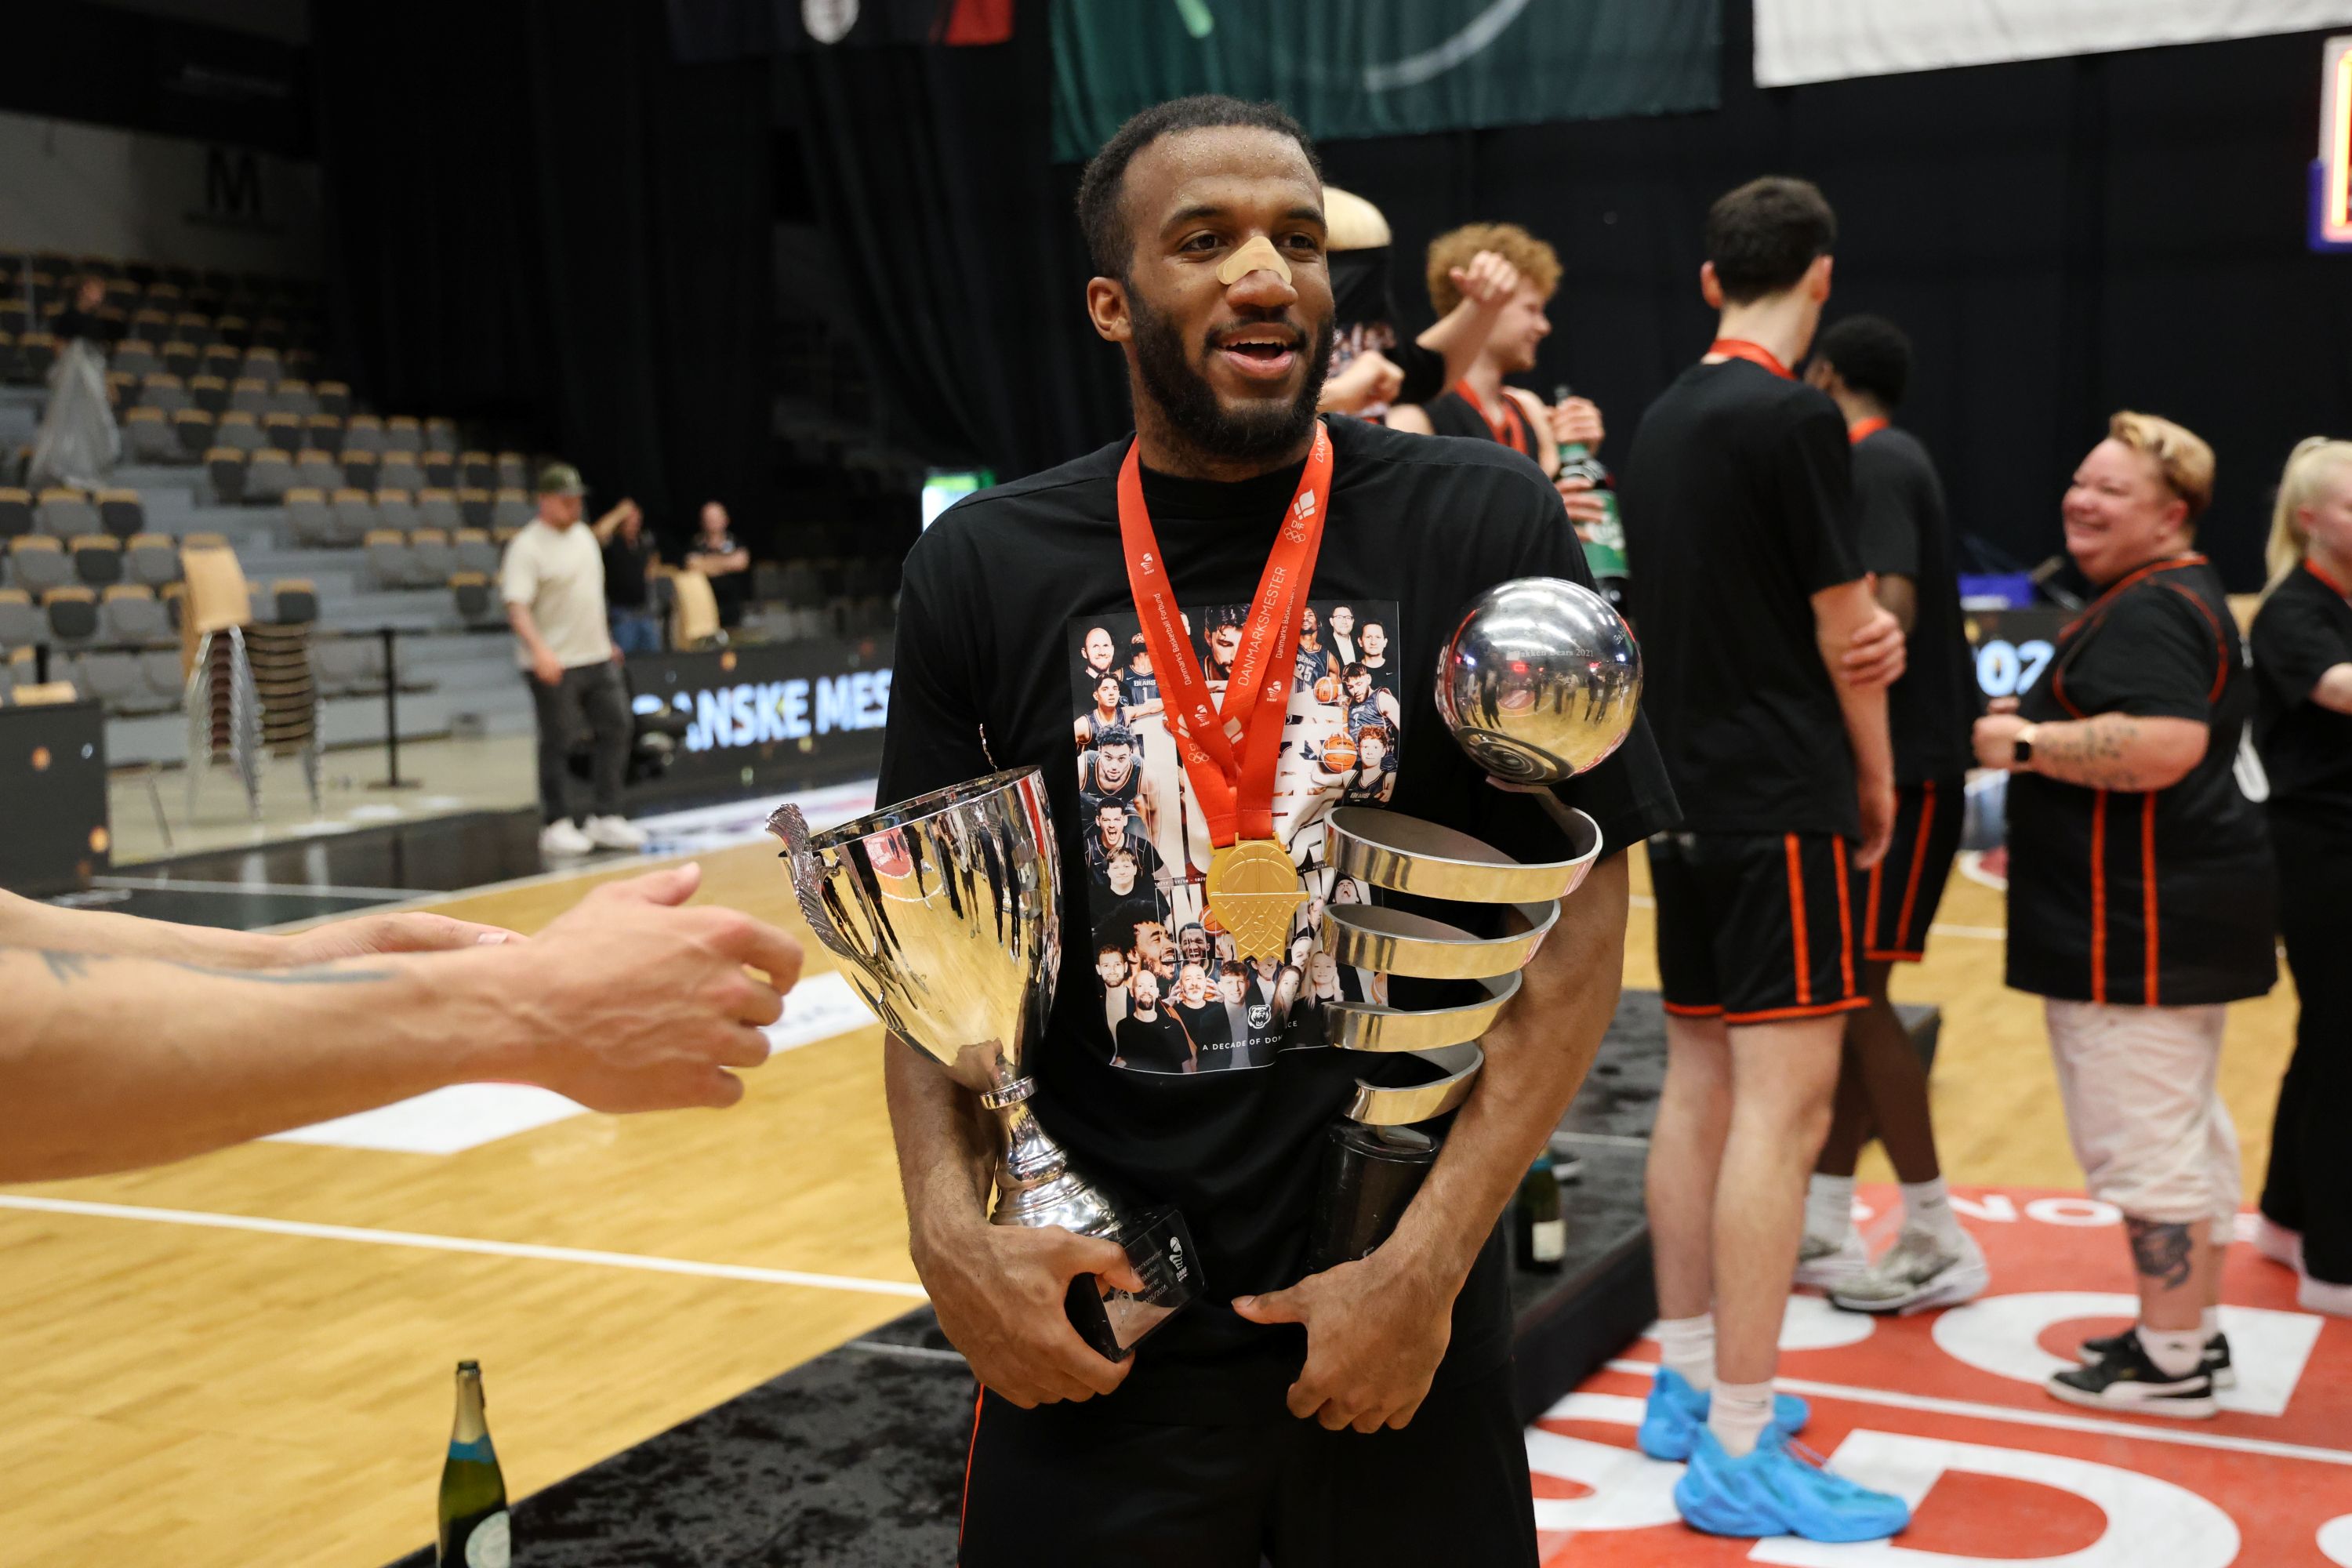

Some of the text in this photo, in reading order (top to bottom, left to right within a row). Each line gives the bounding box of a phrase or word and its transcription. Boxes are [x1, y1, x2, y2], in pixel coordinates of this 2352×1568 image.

[1291, 521, 1305, 530] DIF
[1238, 567, 1287, 686] DANMARKSMESTER
[1153, 593, 1192, 686] Danmarks Basketball Forbund
[1276, 626, 1288, 659] Danmarks
[1576, 648, 1594, 657] 2021
[1212, 1040, 1247, 1051] DECADE
